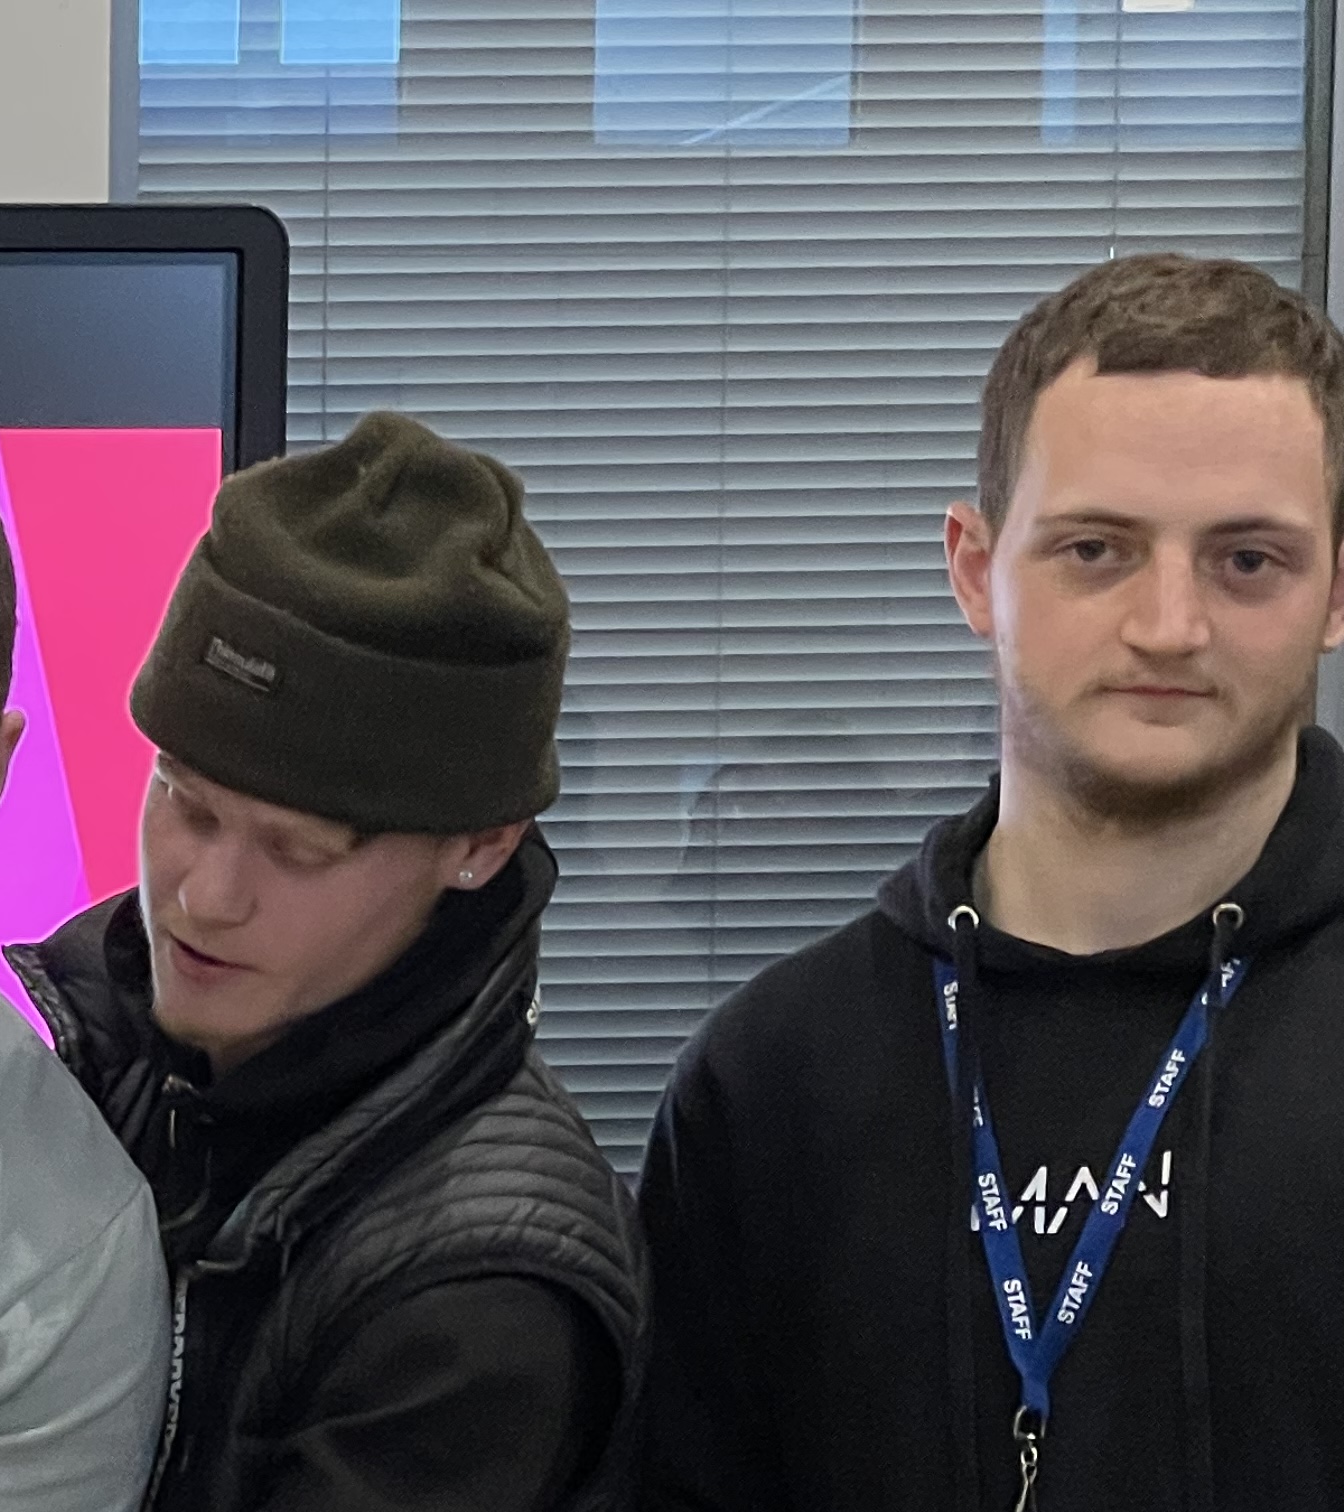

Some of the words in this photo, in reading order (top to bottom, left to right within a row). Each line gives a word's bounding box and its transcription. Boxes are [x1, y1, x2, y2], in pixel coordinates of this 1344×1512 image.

[1148, 1048, 1187, 1109] STAFF
[978, 1172, 1009, 1232] STAFF
[1101, 1152, 1139, 1216] STAFF
[1003, 1277, 1033, 1341] STAFF
[1057, 1260, 1094, 1325] STAFF
